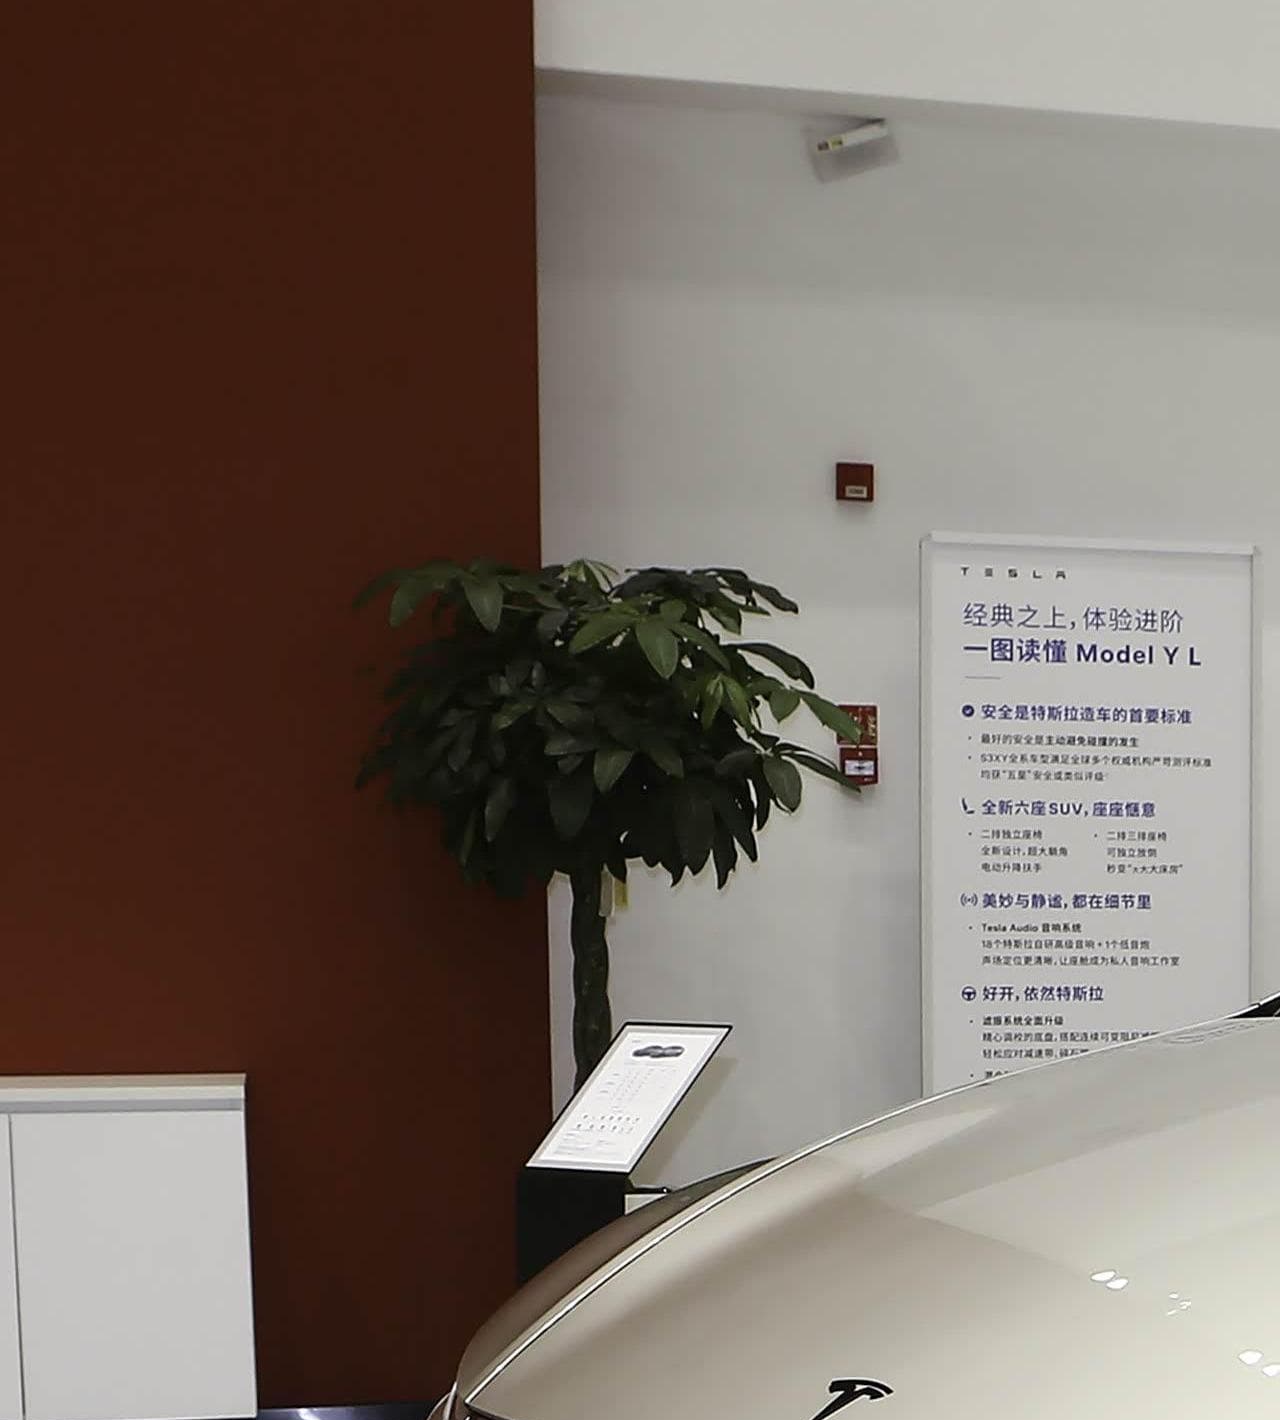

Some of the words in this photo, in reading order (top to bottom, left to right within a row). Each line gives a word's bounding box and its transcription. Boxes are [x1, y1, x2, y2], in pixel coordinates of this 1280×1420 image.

[961, 567, 1066, 579] TESLA
[964, 603, 1183, 633] 经典之上，体验进阶
[964, 638, 1067, 663] 一图读懂
[1077, 644, 1153, 664] Model
[1163, 646, 1179, 665] Y
[1190, 647, 1201, 666] L
[982, 704, 1191, 724] 安全是特斯拉造车的首要标准
[981, 829, 1042, 840] 二排独立座椅
[1107, 831, 1167, 841] 二排三排座椅
[1107, 847, 1157, 858] 可独立放倒
[982, 862, 1041, 873] 电动升降扶手
[983, 893, 1151, 909] 美妙与静谧，都在细节里
[982, 923, 1007, 932] Tesla
[1010, 924, 1038, 932] Audio
[1042, 923, 1081, 933] 音响系统
[983, 986, 1103, 1001] 好开，依然特斯拉
